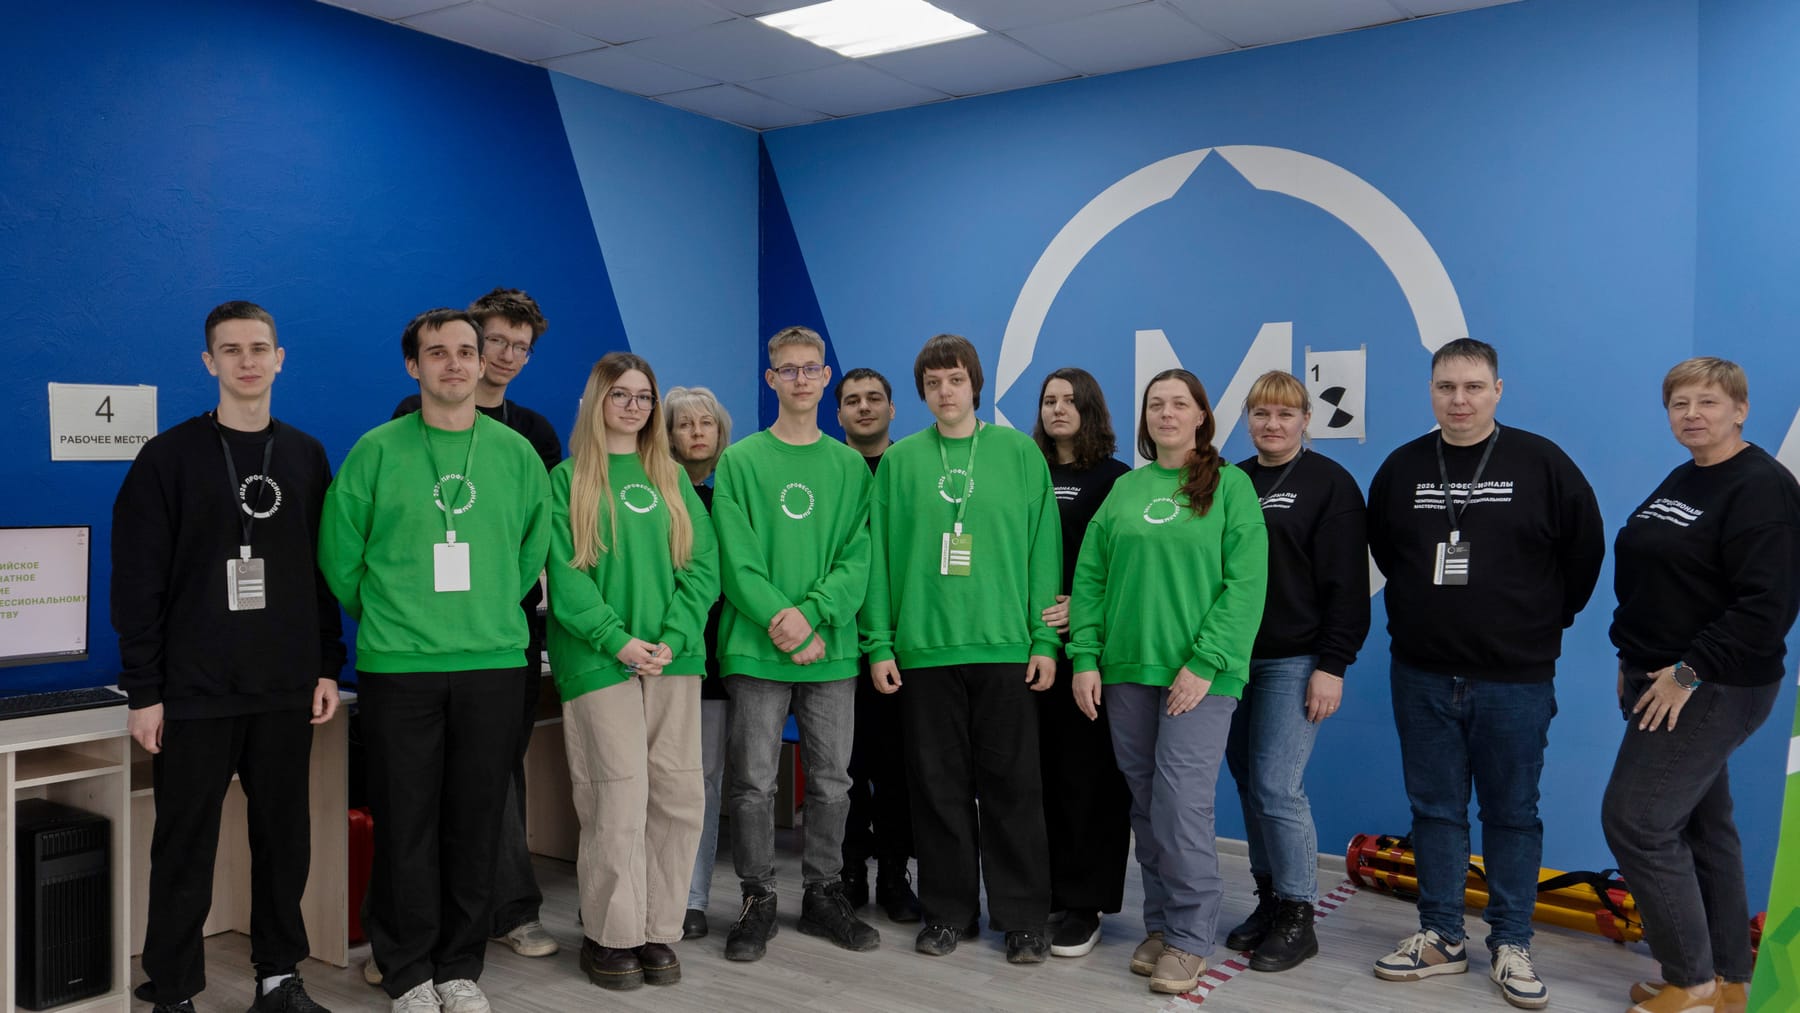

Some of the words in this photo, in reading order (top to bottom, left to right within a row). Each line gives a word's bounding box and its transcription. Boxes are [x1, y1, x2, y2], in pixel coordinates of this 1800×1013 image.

[1311, 364, 1319, 382] 1
[95, 395, 115, 423] 4
[60, 435, 111, 444] РАБОЧЕЕ
[114, 435, 149, 444] МЕСТО
[1440, 481, 1513, 490] ПОФЕСИОНАЛЫ
